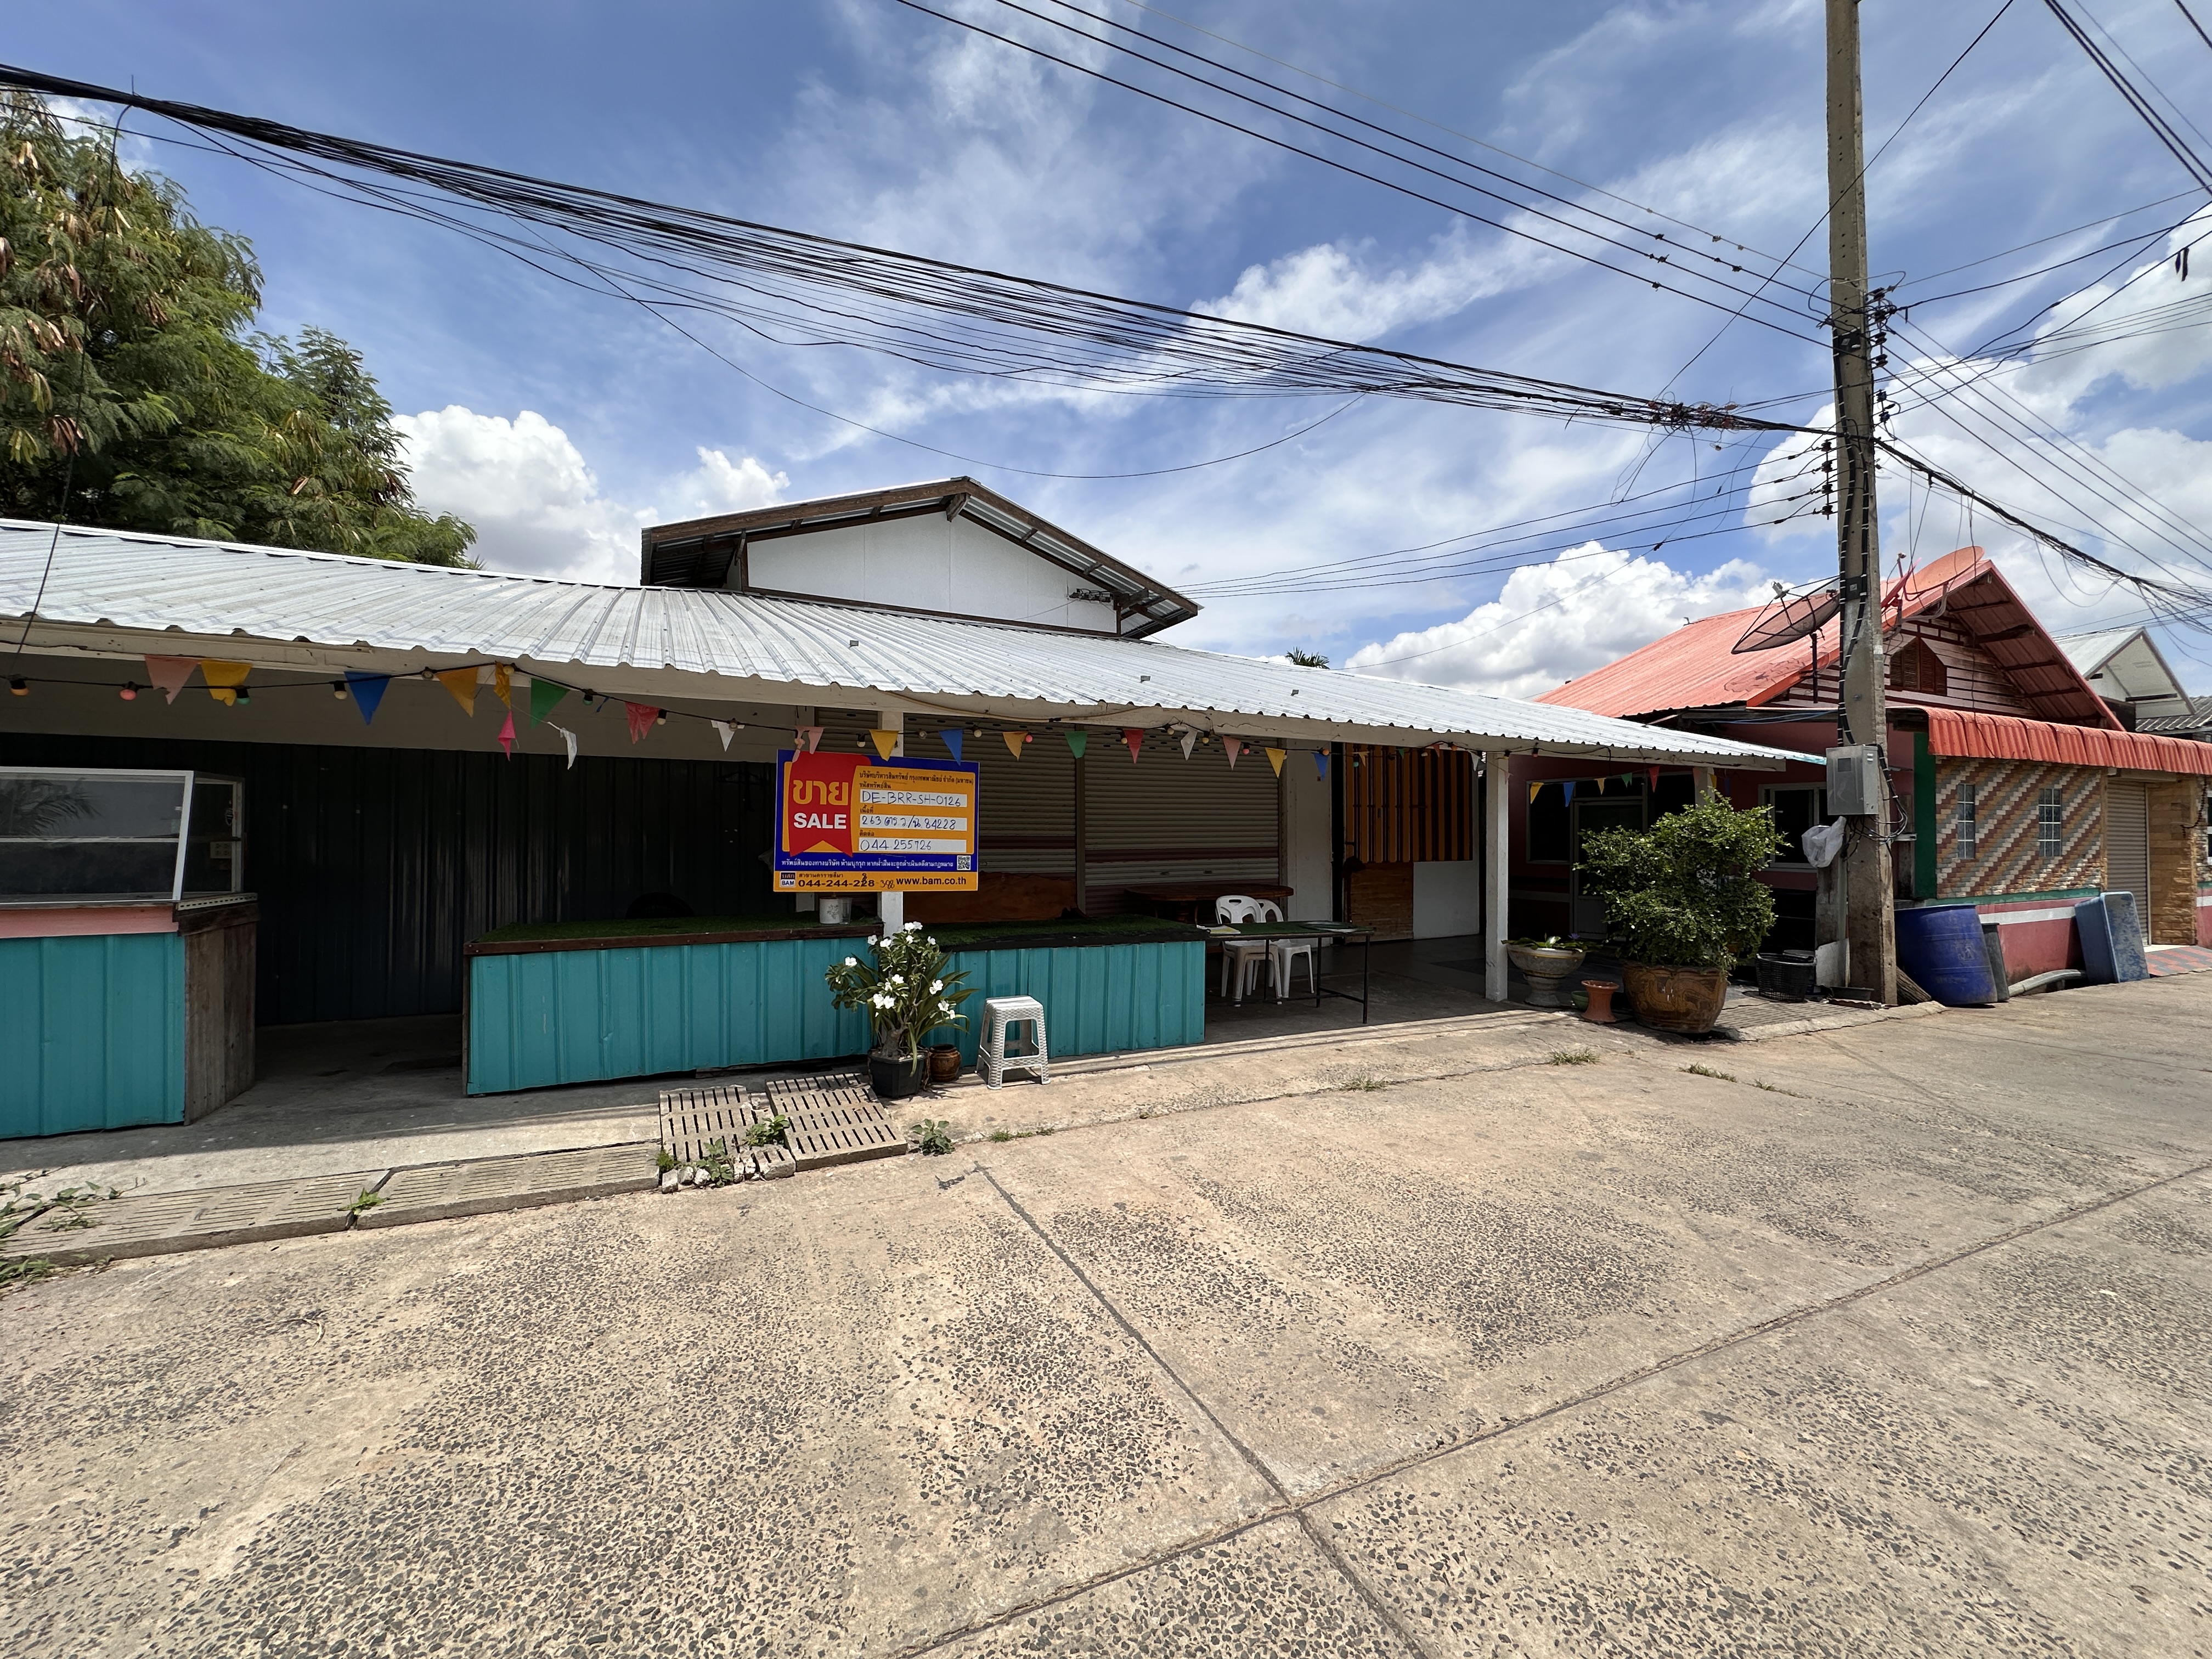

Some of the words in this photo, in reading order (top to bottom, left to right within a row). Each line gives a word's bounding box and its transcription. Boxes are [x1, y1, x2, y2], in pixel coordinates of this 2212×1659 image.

[943, 775, 955, 783] จำกัด
[859, 781, 891, 789] รหัสทรัพย์สิน
[793, 780, 849, 805] ขาย
[862, 790, 961, 807] DE-BRR-SH-0126
[860, 804, 874, 814] เนื้อที่
[793, 812, 847, 829] SALE
[924, 817, 957, 831] 84228
[860, 839, 889, 851] 044
[893, 839, 932, 851] 255726
[781, 857, 840, 866] ทรัพย์สินของทางบริษัท
[841, 859, 866, 868] ห้ามบุกรุก
[896, 876, 967, 885] www.bam.co.th
